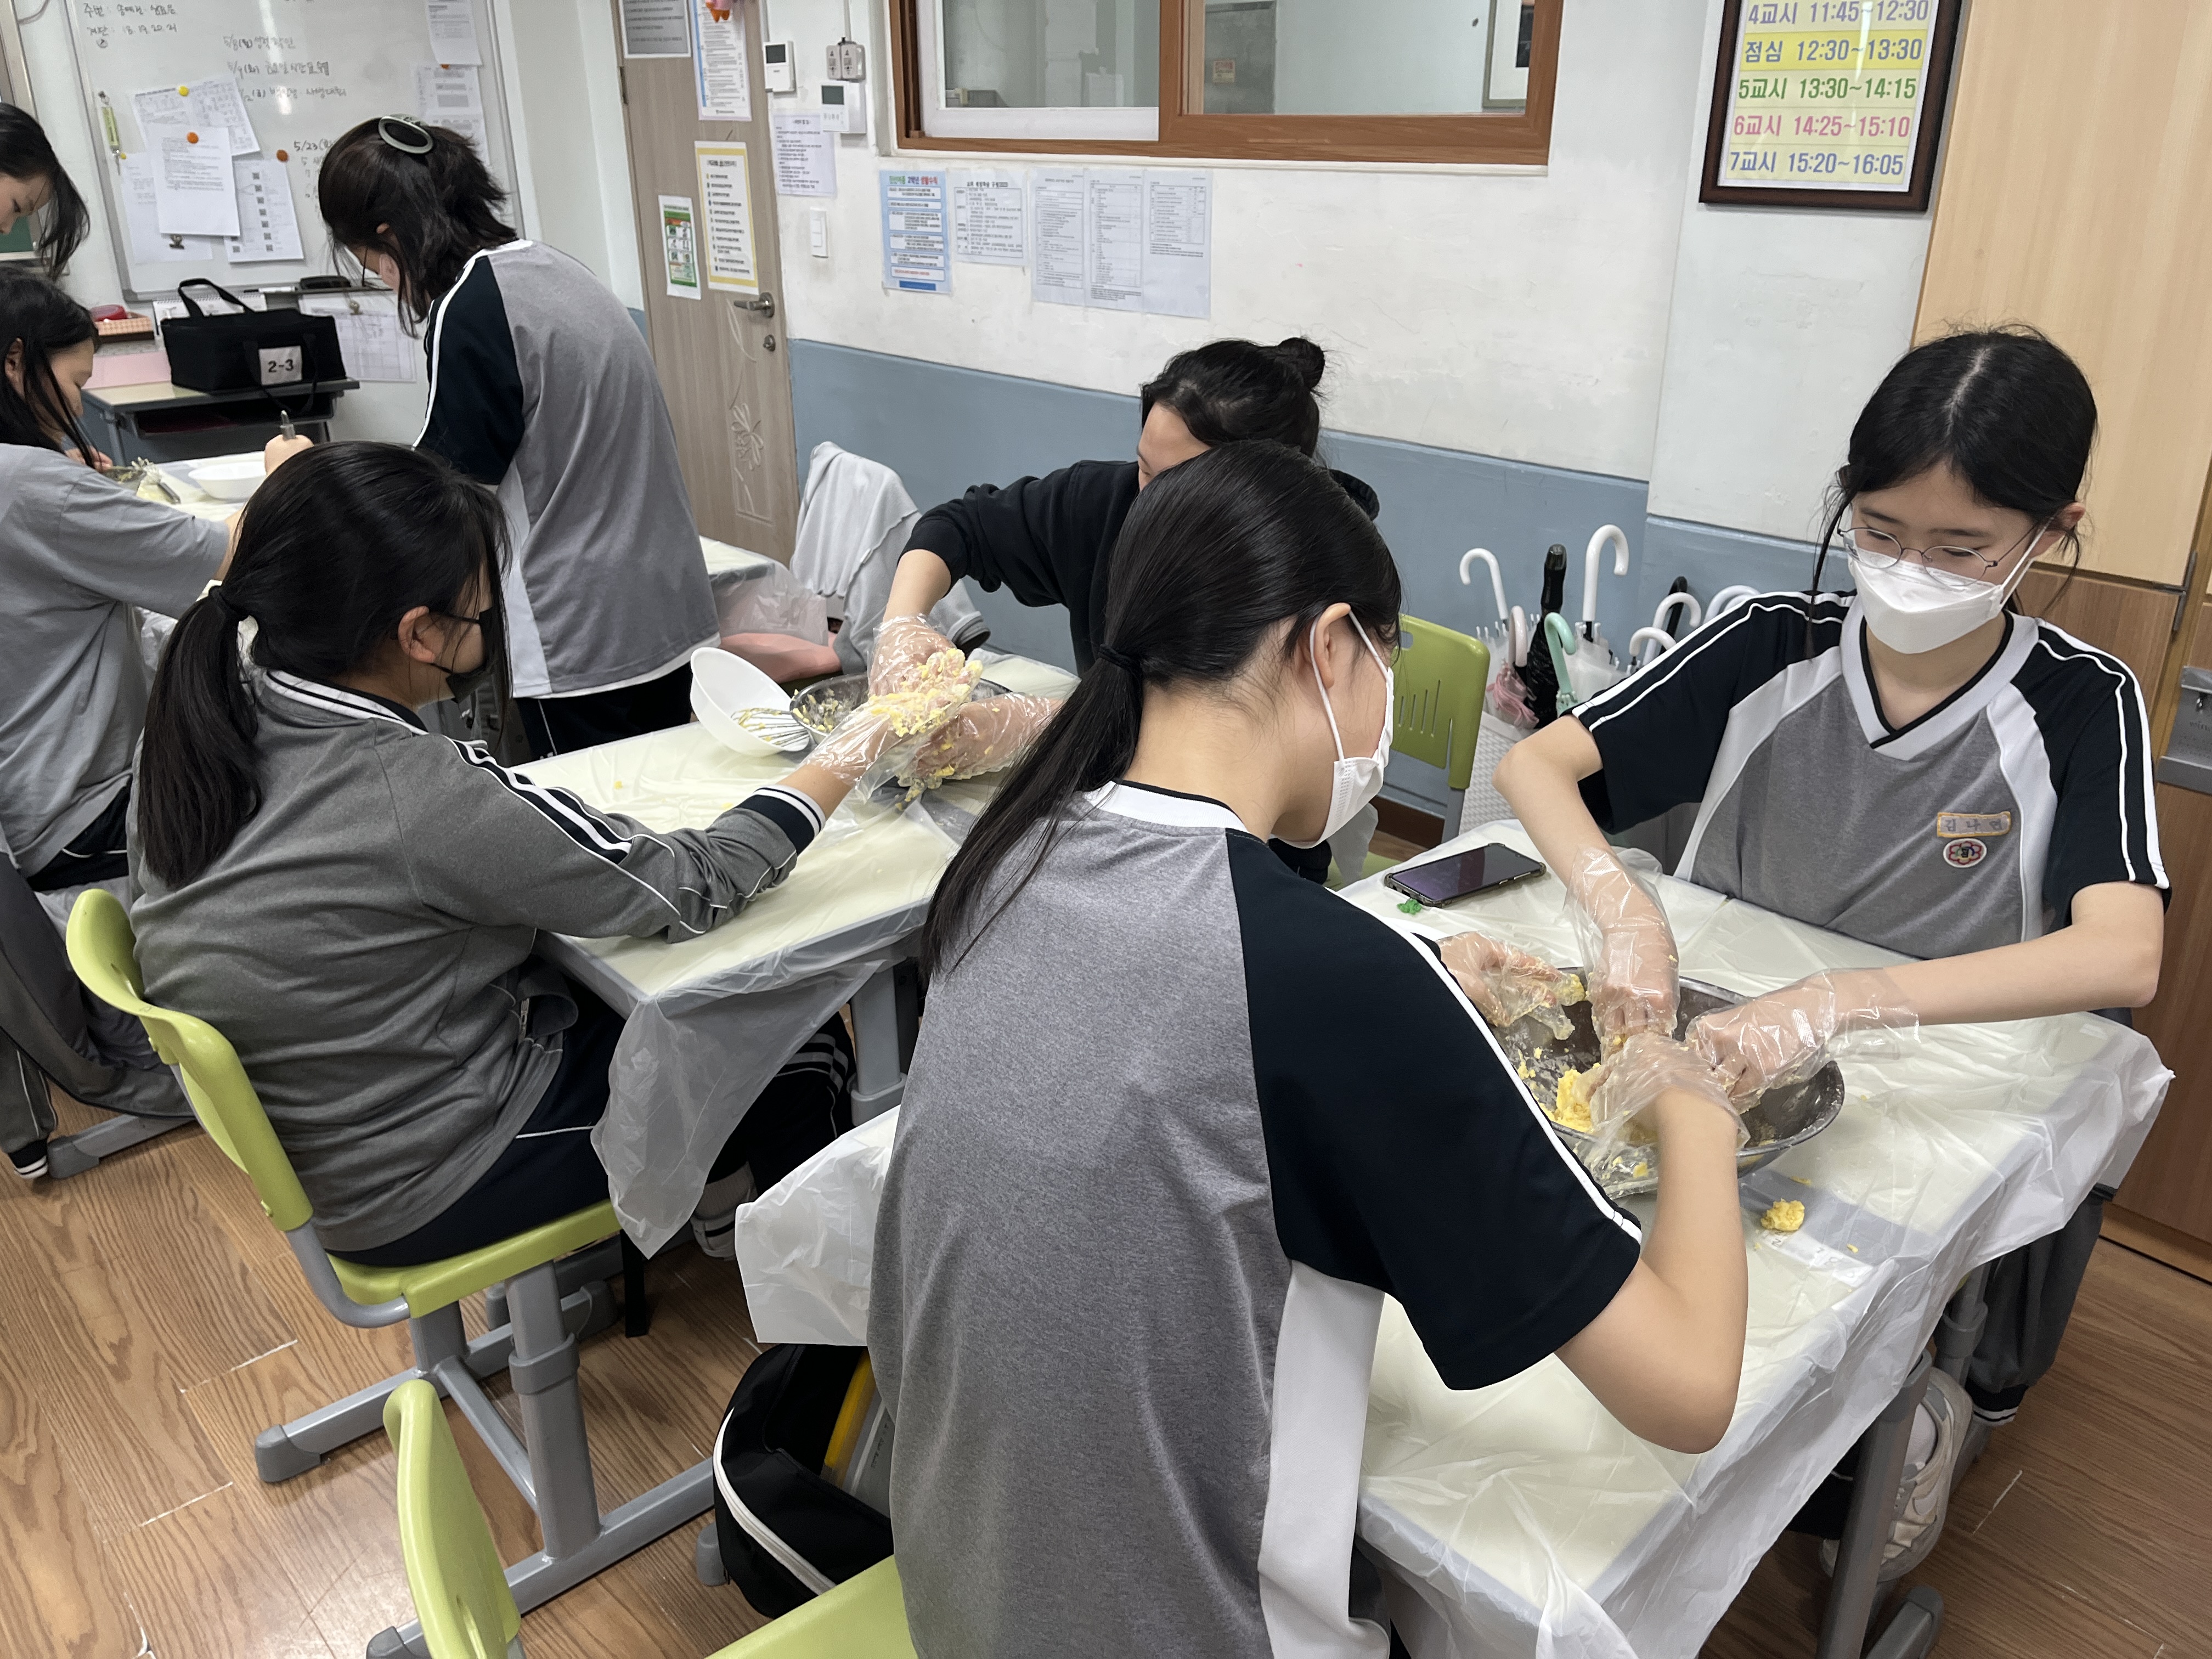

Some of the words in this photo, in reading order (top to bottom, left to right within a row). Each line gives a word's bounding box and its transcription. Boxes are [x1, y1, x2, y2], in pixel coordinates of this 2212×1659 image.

[1748, 2, 1798, 25] 4교시
[1810, 0, 1928, 23] 11:45~12:30
[1745, 40, 1783, 64] 점심
[1797, 38, 1922, 61] 12:30~13:30
[1738, 77, 1787, 100] 5교시
[1799, 77, 1917, 100] 13:30~14:15
[1733, 115, 1782, 137] 6교시
[1793, 115, 1911, 138] 14:25~15:10
[1730, 151, 1777, 173] 7교시
[1788, 151, 1904, 176] 15:20~16:05
[268, 358, 294, 373] 2-3
